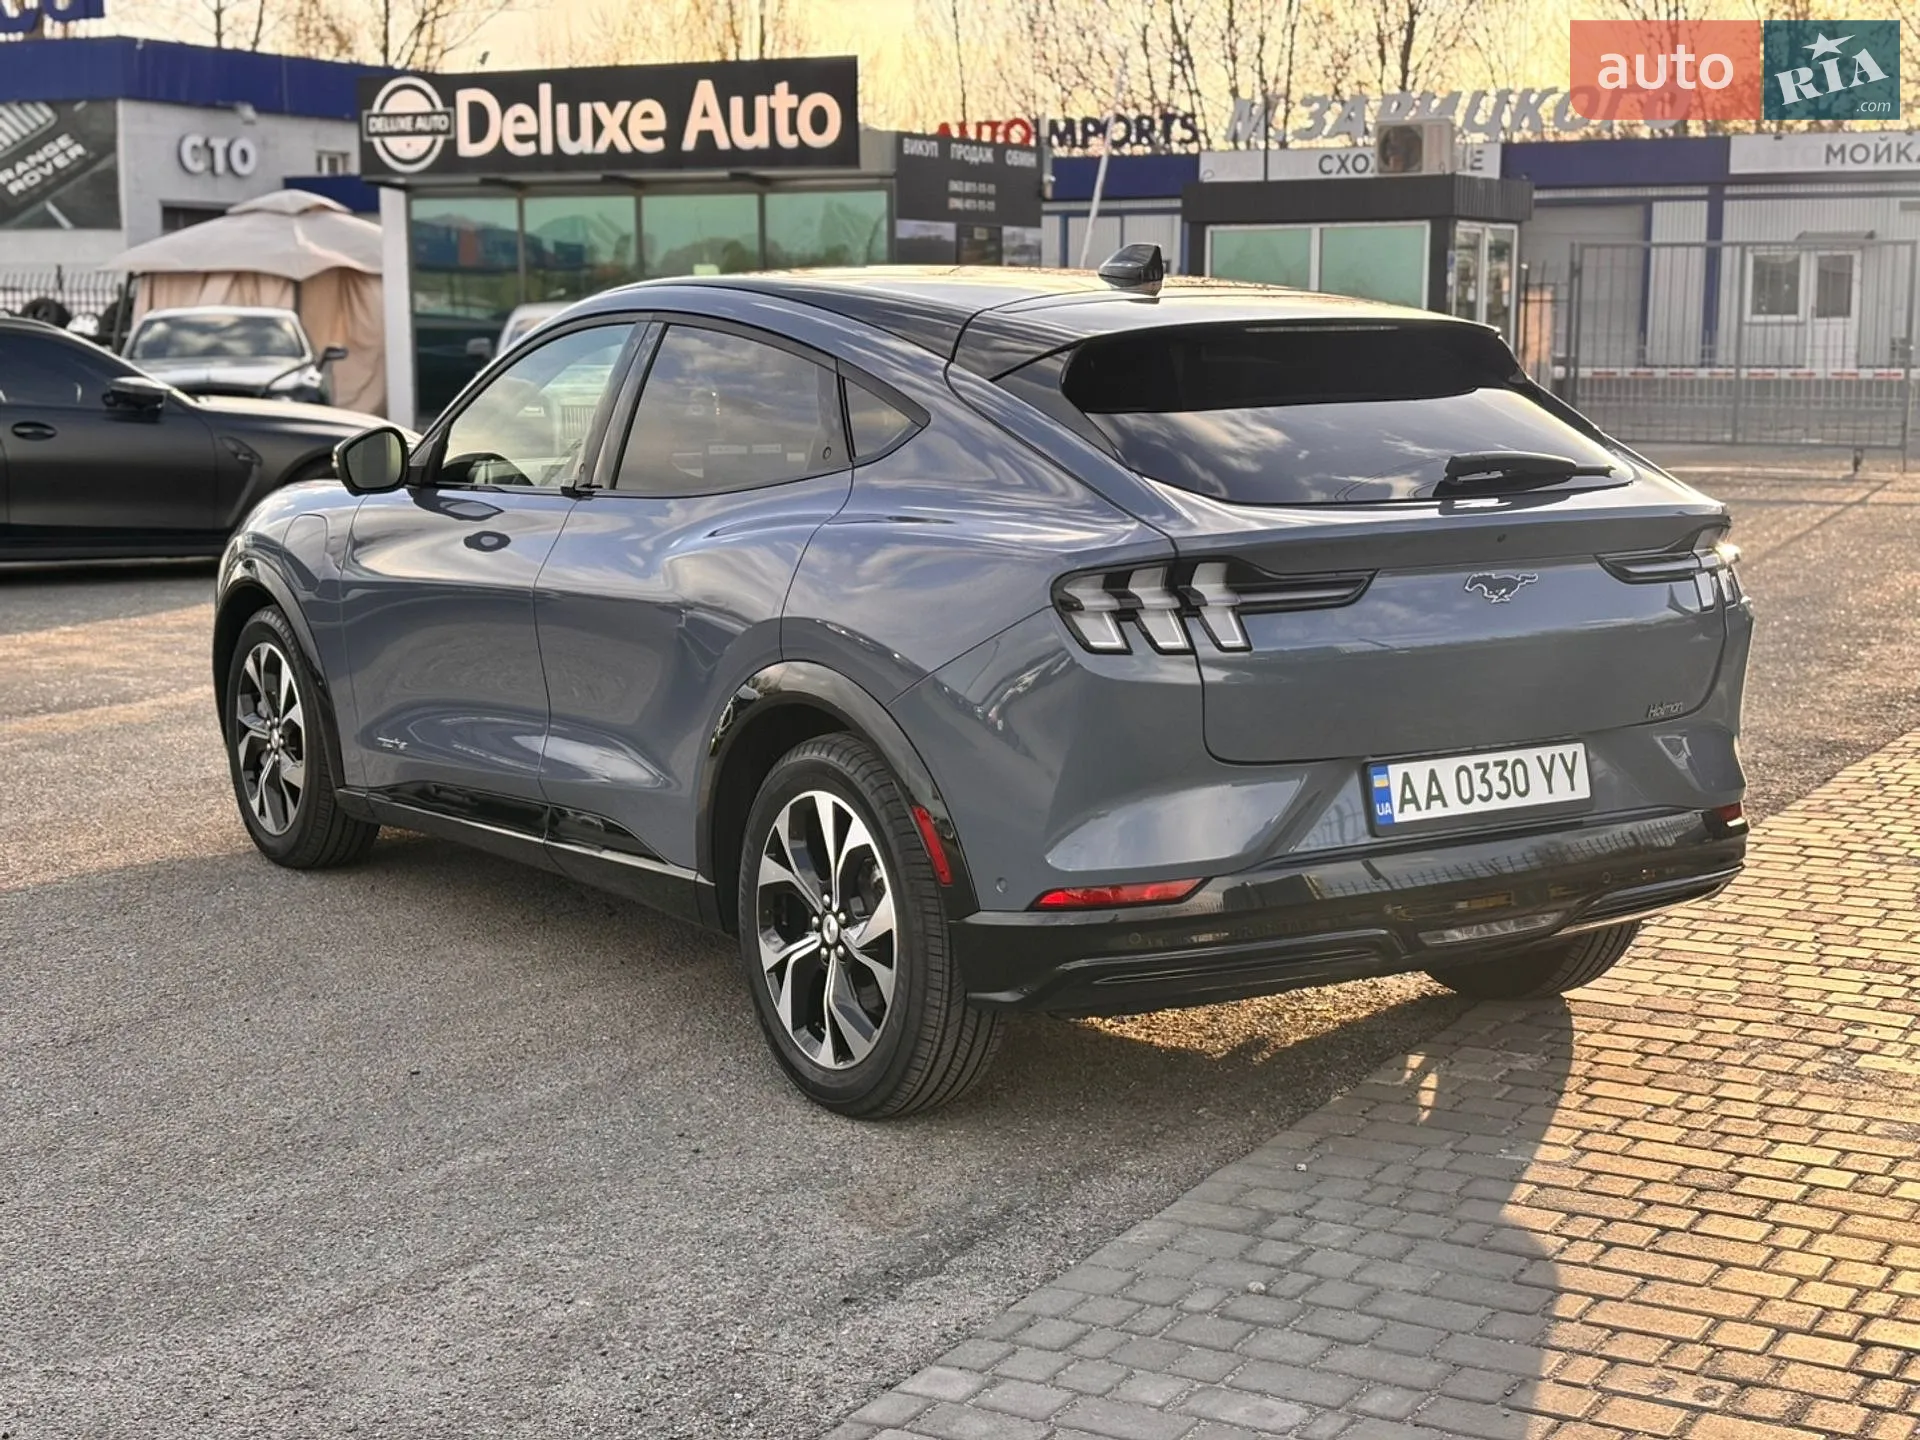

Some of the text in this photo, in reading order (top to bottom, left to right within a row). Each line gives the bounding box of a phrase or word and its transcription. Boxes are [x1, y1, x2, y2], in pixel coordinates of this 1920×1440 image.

[368, 114, 449, 134] DELUXE AUTO
[455, 79, 842, 157] Deluxe Auto
[0, 133, 75, 185] RANGE
[6, 143, 87, 196] ROVER
[177, 133, 257, 178] СТО
[1398, 750, 1578, 814] AA 0330 YY
[1376, 802, 1393, 816] UA
